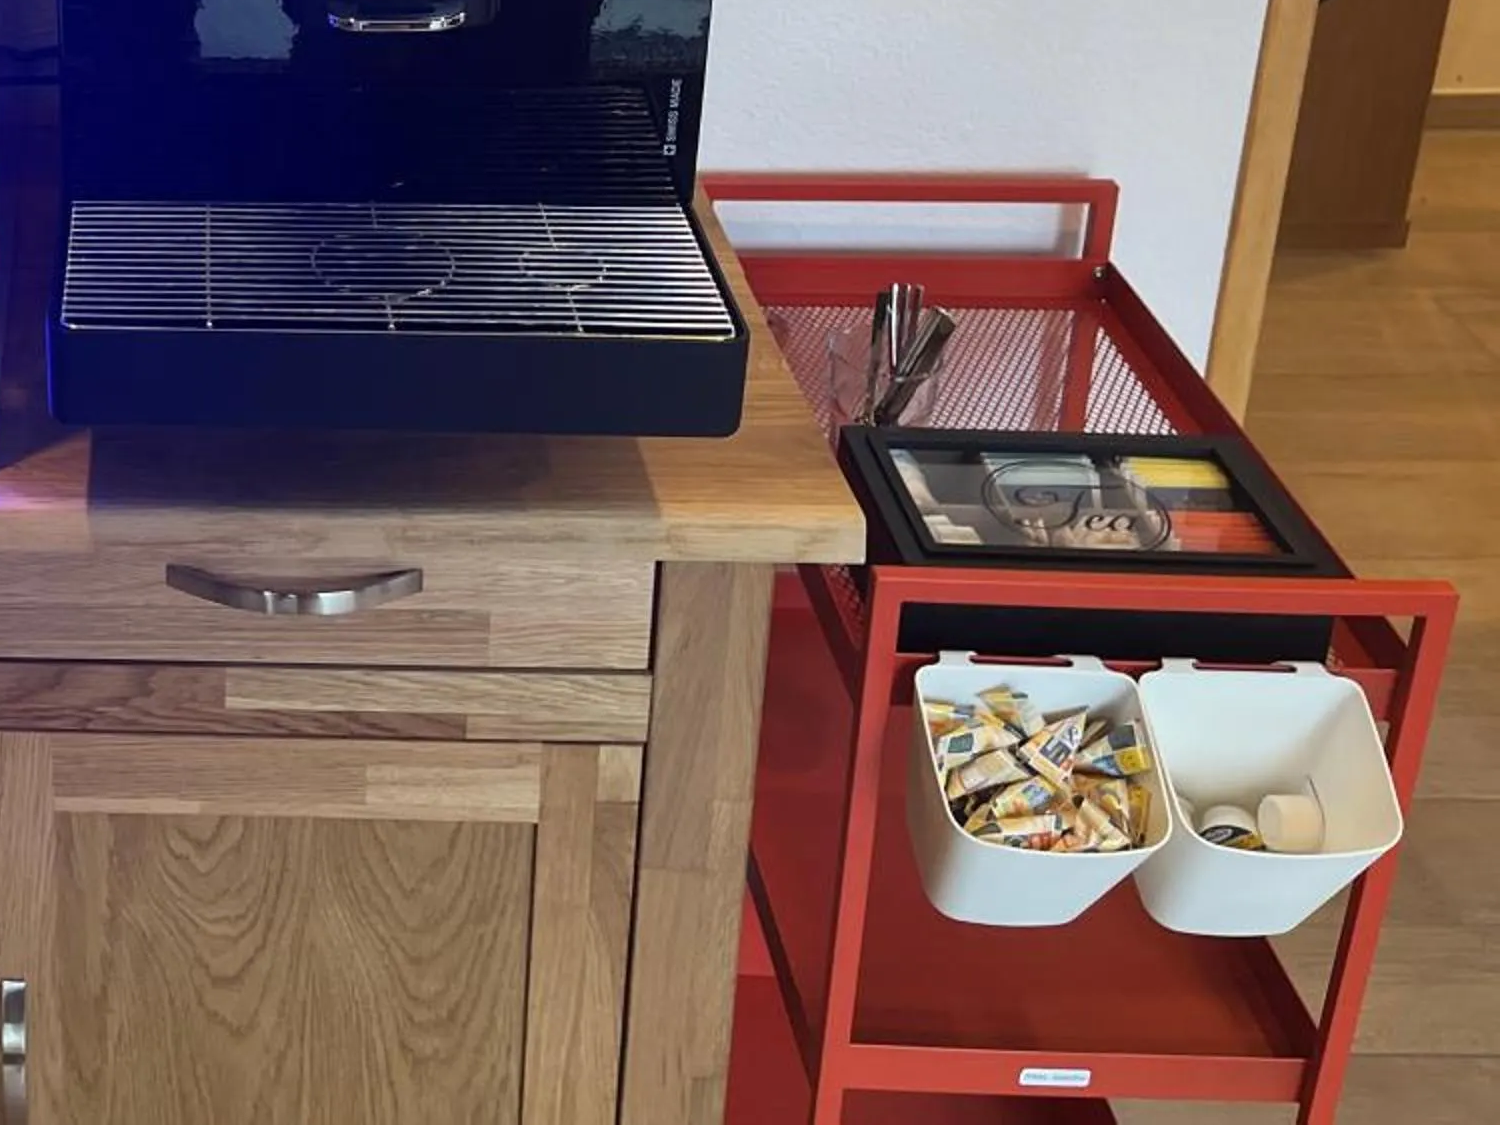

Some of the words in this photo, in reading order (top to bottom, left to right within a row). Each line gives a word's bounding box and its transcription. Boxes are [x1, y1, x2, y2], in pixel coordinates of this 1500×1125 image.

[669, 78, 683, 108] MADE
[666, 110, 679, 142] SWISS
[1014, 485, 1136, 531] Tea
